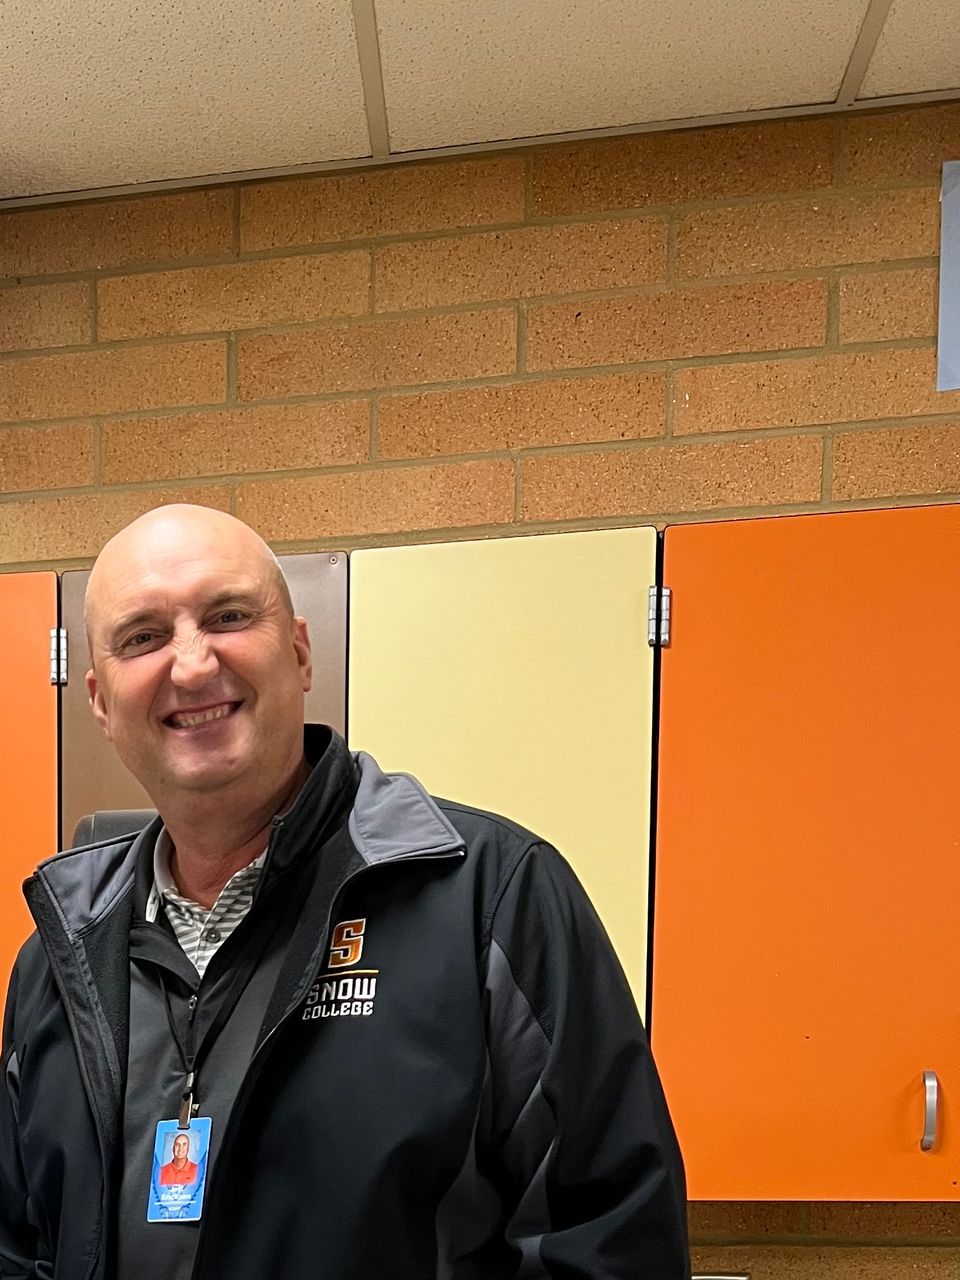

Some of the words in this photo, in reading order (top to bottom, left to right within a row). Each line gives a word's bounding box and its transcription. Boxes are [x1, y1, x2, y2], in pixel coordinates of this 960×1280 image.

[328, 918, 366, 968] S
[306, 978, 377, 1005] SNOW
[302, 1001, 374, 1020] COLLEGE
